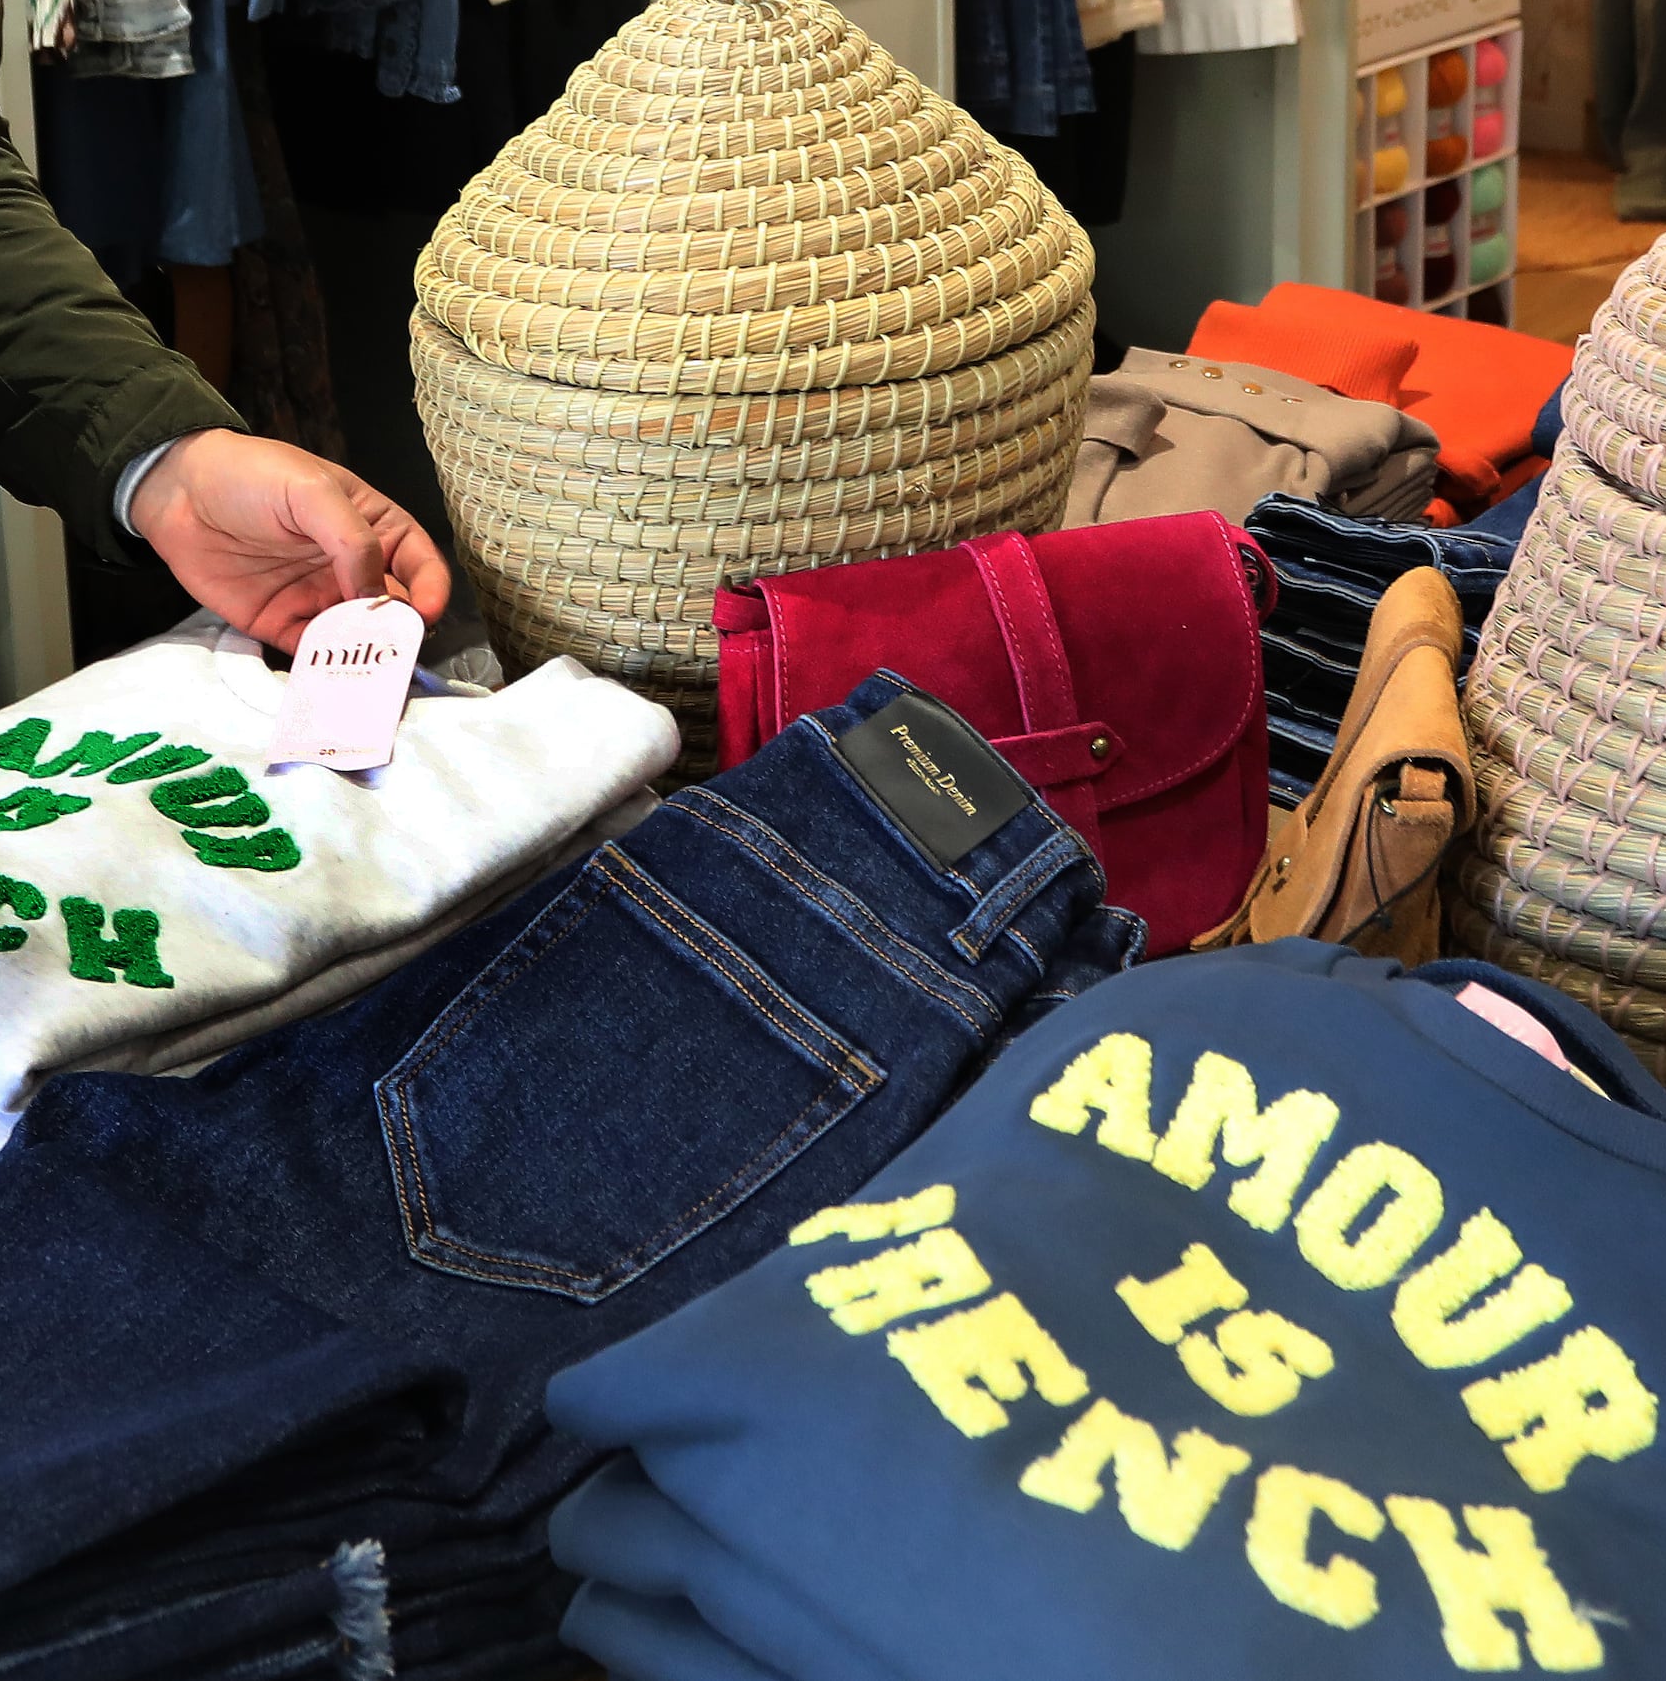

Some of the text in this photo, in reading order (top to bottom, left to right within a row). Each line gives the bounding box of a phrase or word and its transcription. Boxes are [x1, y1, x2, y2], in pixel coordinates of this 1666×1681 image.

[889, 724, 941, 777] Premium
[935, 772, 977, 816] Denim
[1029, 1032, 1659, 1492] AMOUR
[1116, 1242, 1335, 1417] IS
